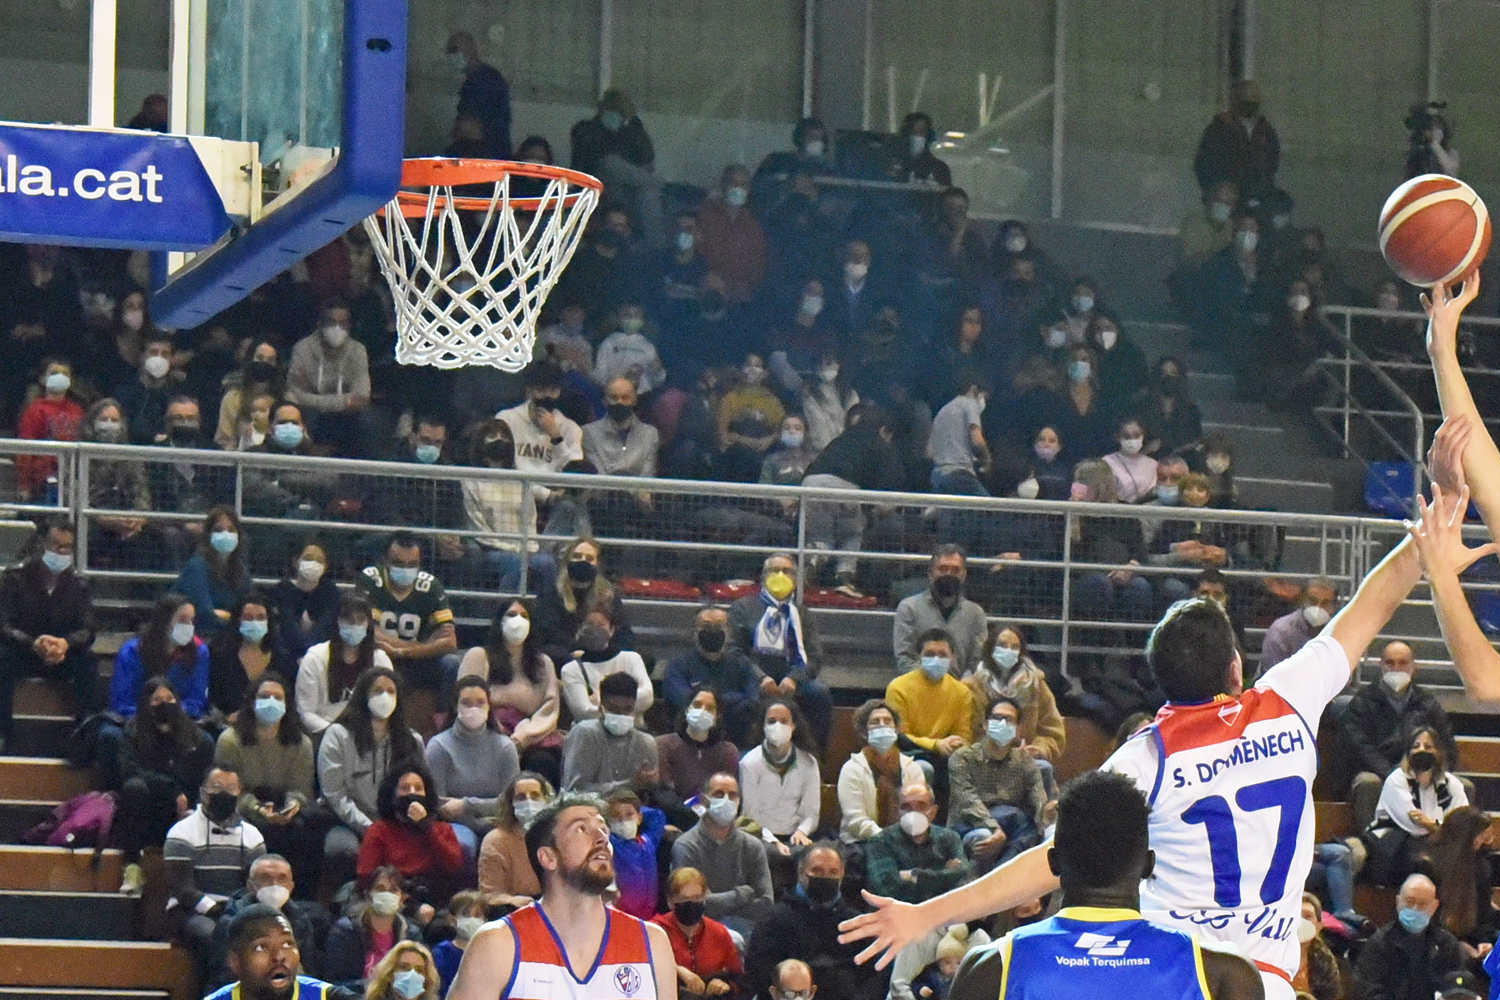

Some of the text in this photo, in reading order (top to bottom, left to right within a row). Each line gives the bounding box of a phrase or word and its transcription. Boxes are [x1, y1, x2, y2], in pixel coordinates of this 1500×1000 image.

[0, 154, 163, 203] la.cat
[1173, 767, 1192, 788] S.
[1180, 775, 1307, 908] 17
[1055, 955, 1151, 969] Vopak Terquimsa
